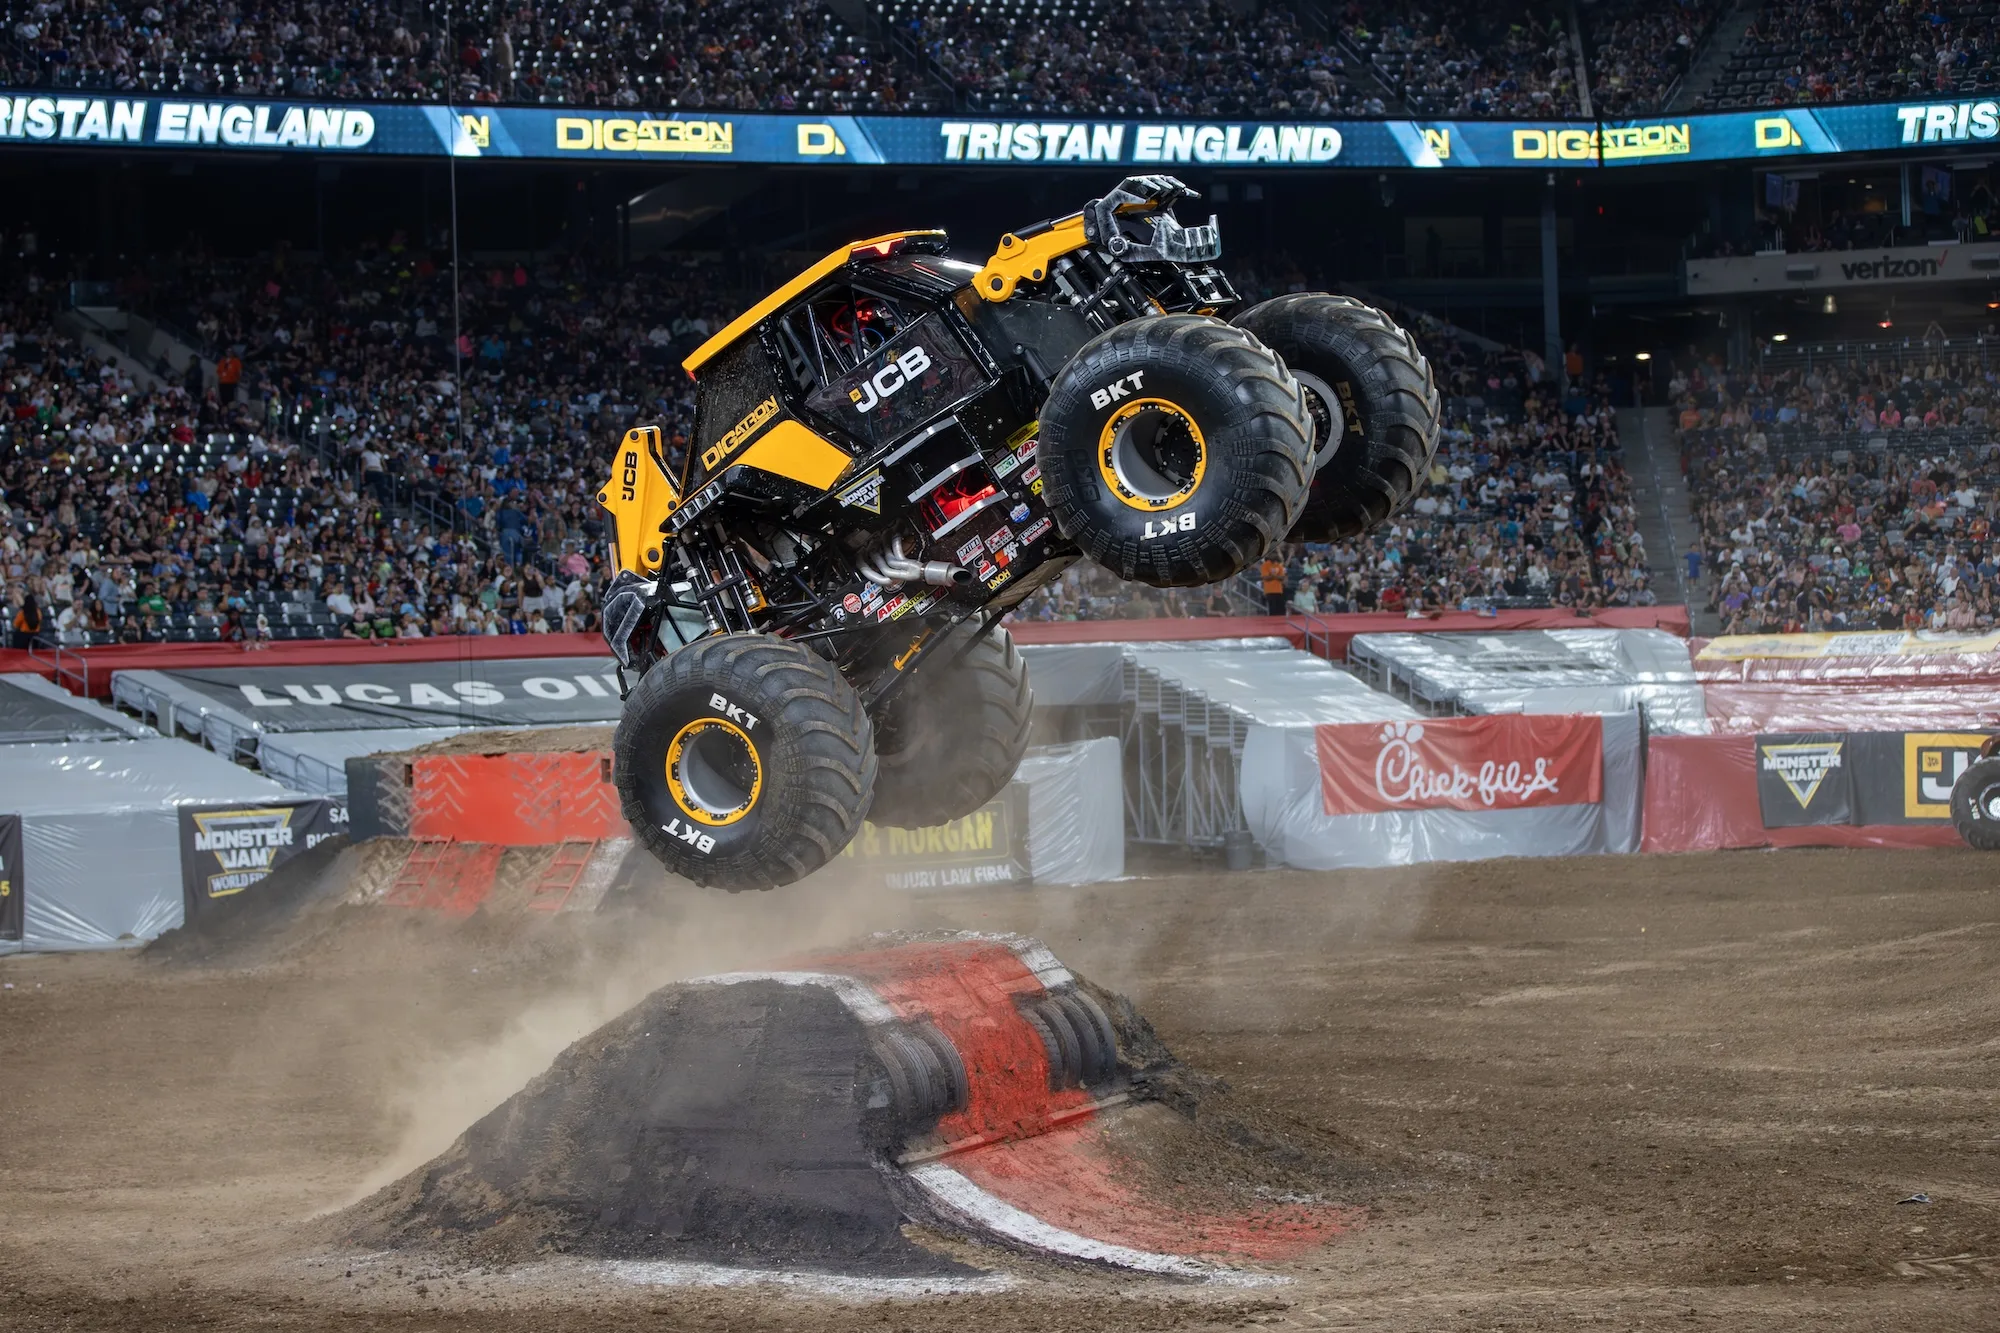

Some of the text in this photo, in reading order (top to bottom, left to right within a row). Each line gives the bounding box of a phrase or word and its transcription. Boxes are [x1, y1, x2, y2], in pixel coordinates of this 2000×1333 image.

[155, 101, 375, 149] ENGLAND
[556, 118, 733, 151] DIGATRON
[1897, 102, 2000, 144] TRIS
[941, 122, 1342, 163] TRISTAN ENGLAND
[1513, 124, 1690, 159] DIGATRON
[1841, 254, 1938, 281] verizon
[855, 346, 931, 413] JCB
[1089, 370, 1144, 411] BKT
[1336, 381, 1365, 436] BKT
[701, 395, 780, 471] DIGATRON
[622, 451, 637, 502] JCB
[840, 475, 885, 508] MONSTER
[859, 488, 878, 506] JAM
[1021, 519, 1044, 540] LINCOLN
[1140, 512, 1196, 541] BKT
[987, 569, 1011, 590] UNOH
[878, 593, 905, 619] ARP
[892, 590, 925, 619] MAGNAFLOW
[239, 680, 505, 707] LUCAS
[709, 693, 760, 731] BKT
[1376, 737, 1559, 805] Chick-fil-A
[1763, 754, 1841, 770] MONSTER
[1786, 769, 1821, 781] JAM
[194, 827, 293, 851] MONSTER
[661, 817, 717, 855] BKT
[222, 848, 268, 868] JAM
[211, 873, 249, 892] WORLD
[885, 864, 1012, 889] INJURY LAW FIRM
